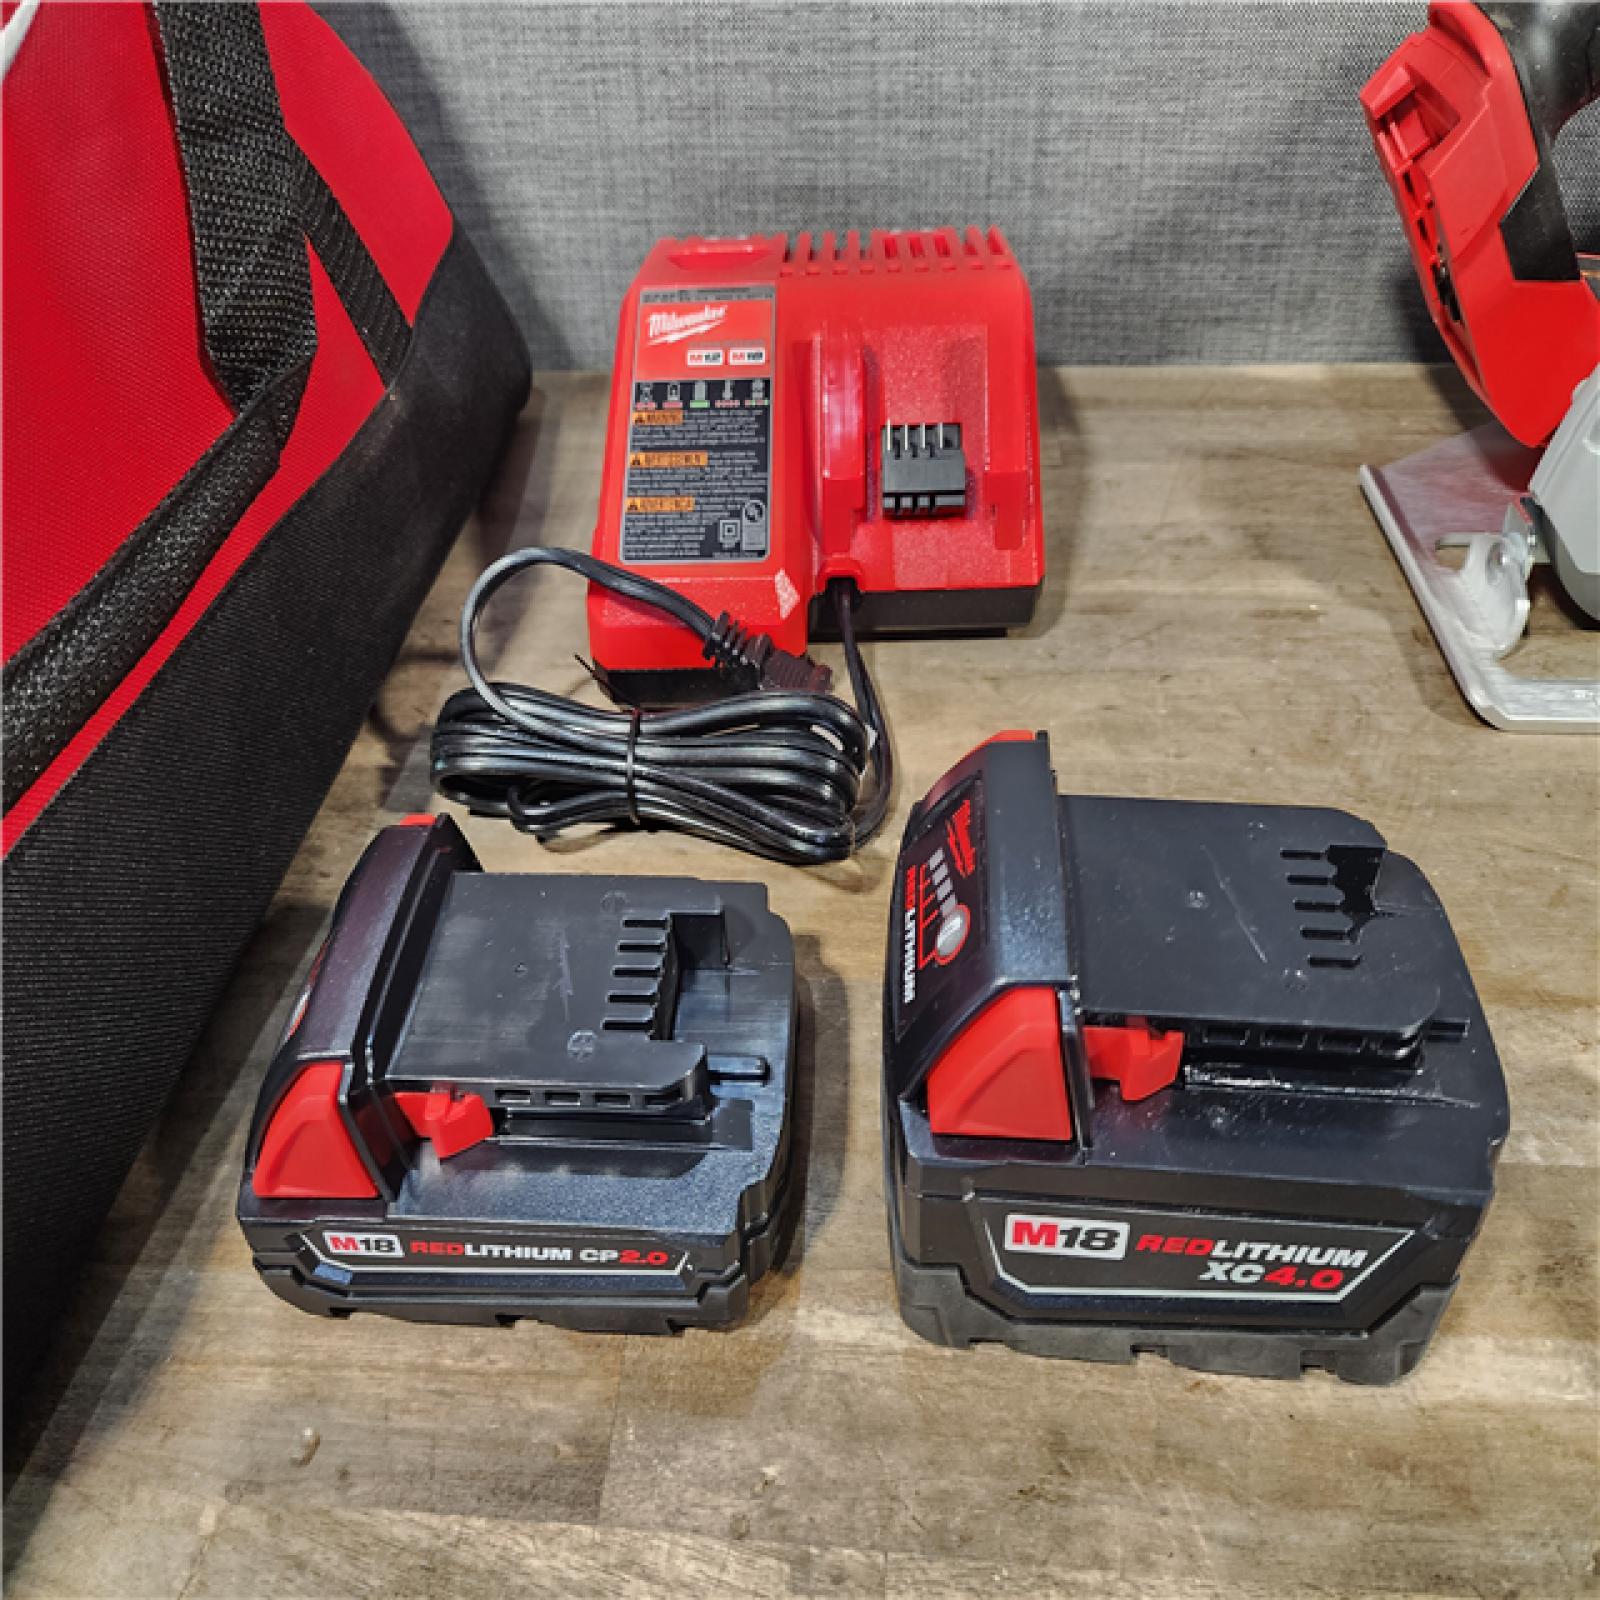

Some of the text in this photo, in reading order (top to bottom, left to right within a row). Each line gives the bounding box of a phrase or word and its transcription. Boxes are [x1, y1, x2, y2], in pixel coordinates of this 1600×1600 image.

[329, 1235, 669, 1266] M18 REDLITHIUM CP2.0
[1011, 1221, 1369, 1269] M18 REDLITHIUM
[1198, 1261, 1345, 1290] XC4.0
